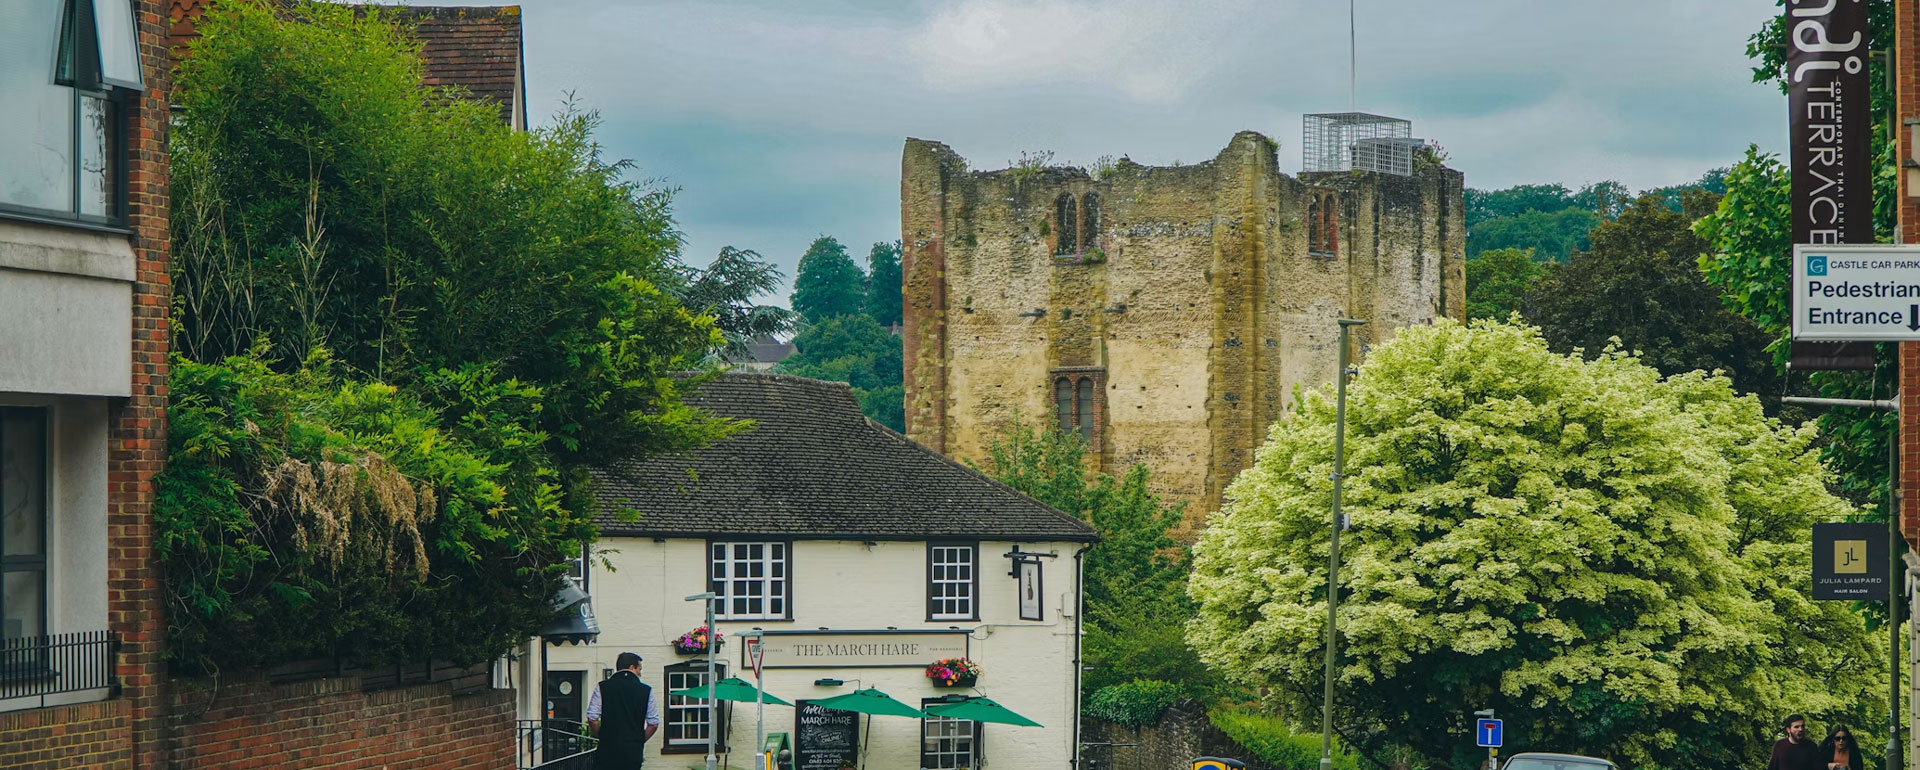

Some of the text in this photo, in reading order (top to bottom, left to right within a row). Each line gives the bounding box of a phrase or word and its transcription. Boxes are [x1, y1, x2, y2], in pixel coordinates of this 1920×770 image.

[1835, 81, 1844, 167] CONTEMPORARY
[1807, 82, 1838, 244] TERRACE
[1830, 261, 1920, 269] CASTLE CAR PARK
[1809, 281, 1920, 298] Pedestrian
[1809, 307, 1902, 325] Entrance
[793, 643, 919, 656] THE MARCH HARE
[801, 716, 852, 726] MARCH HARE
